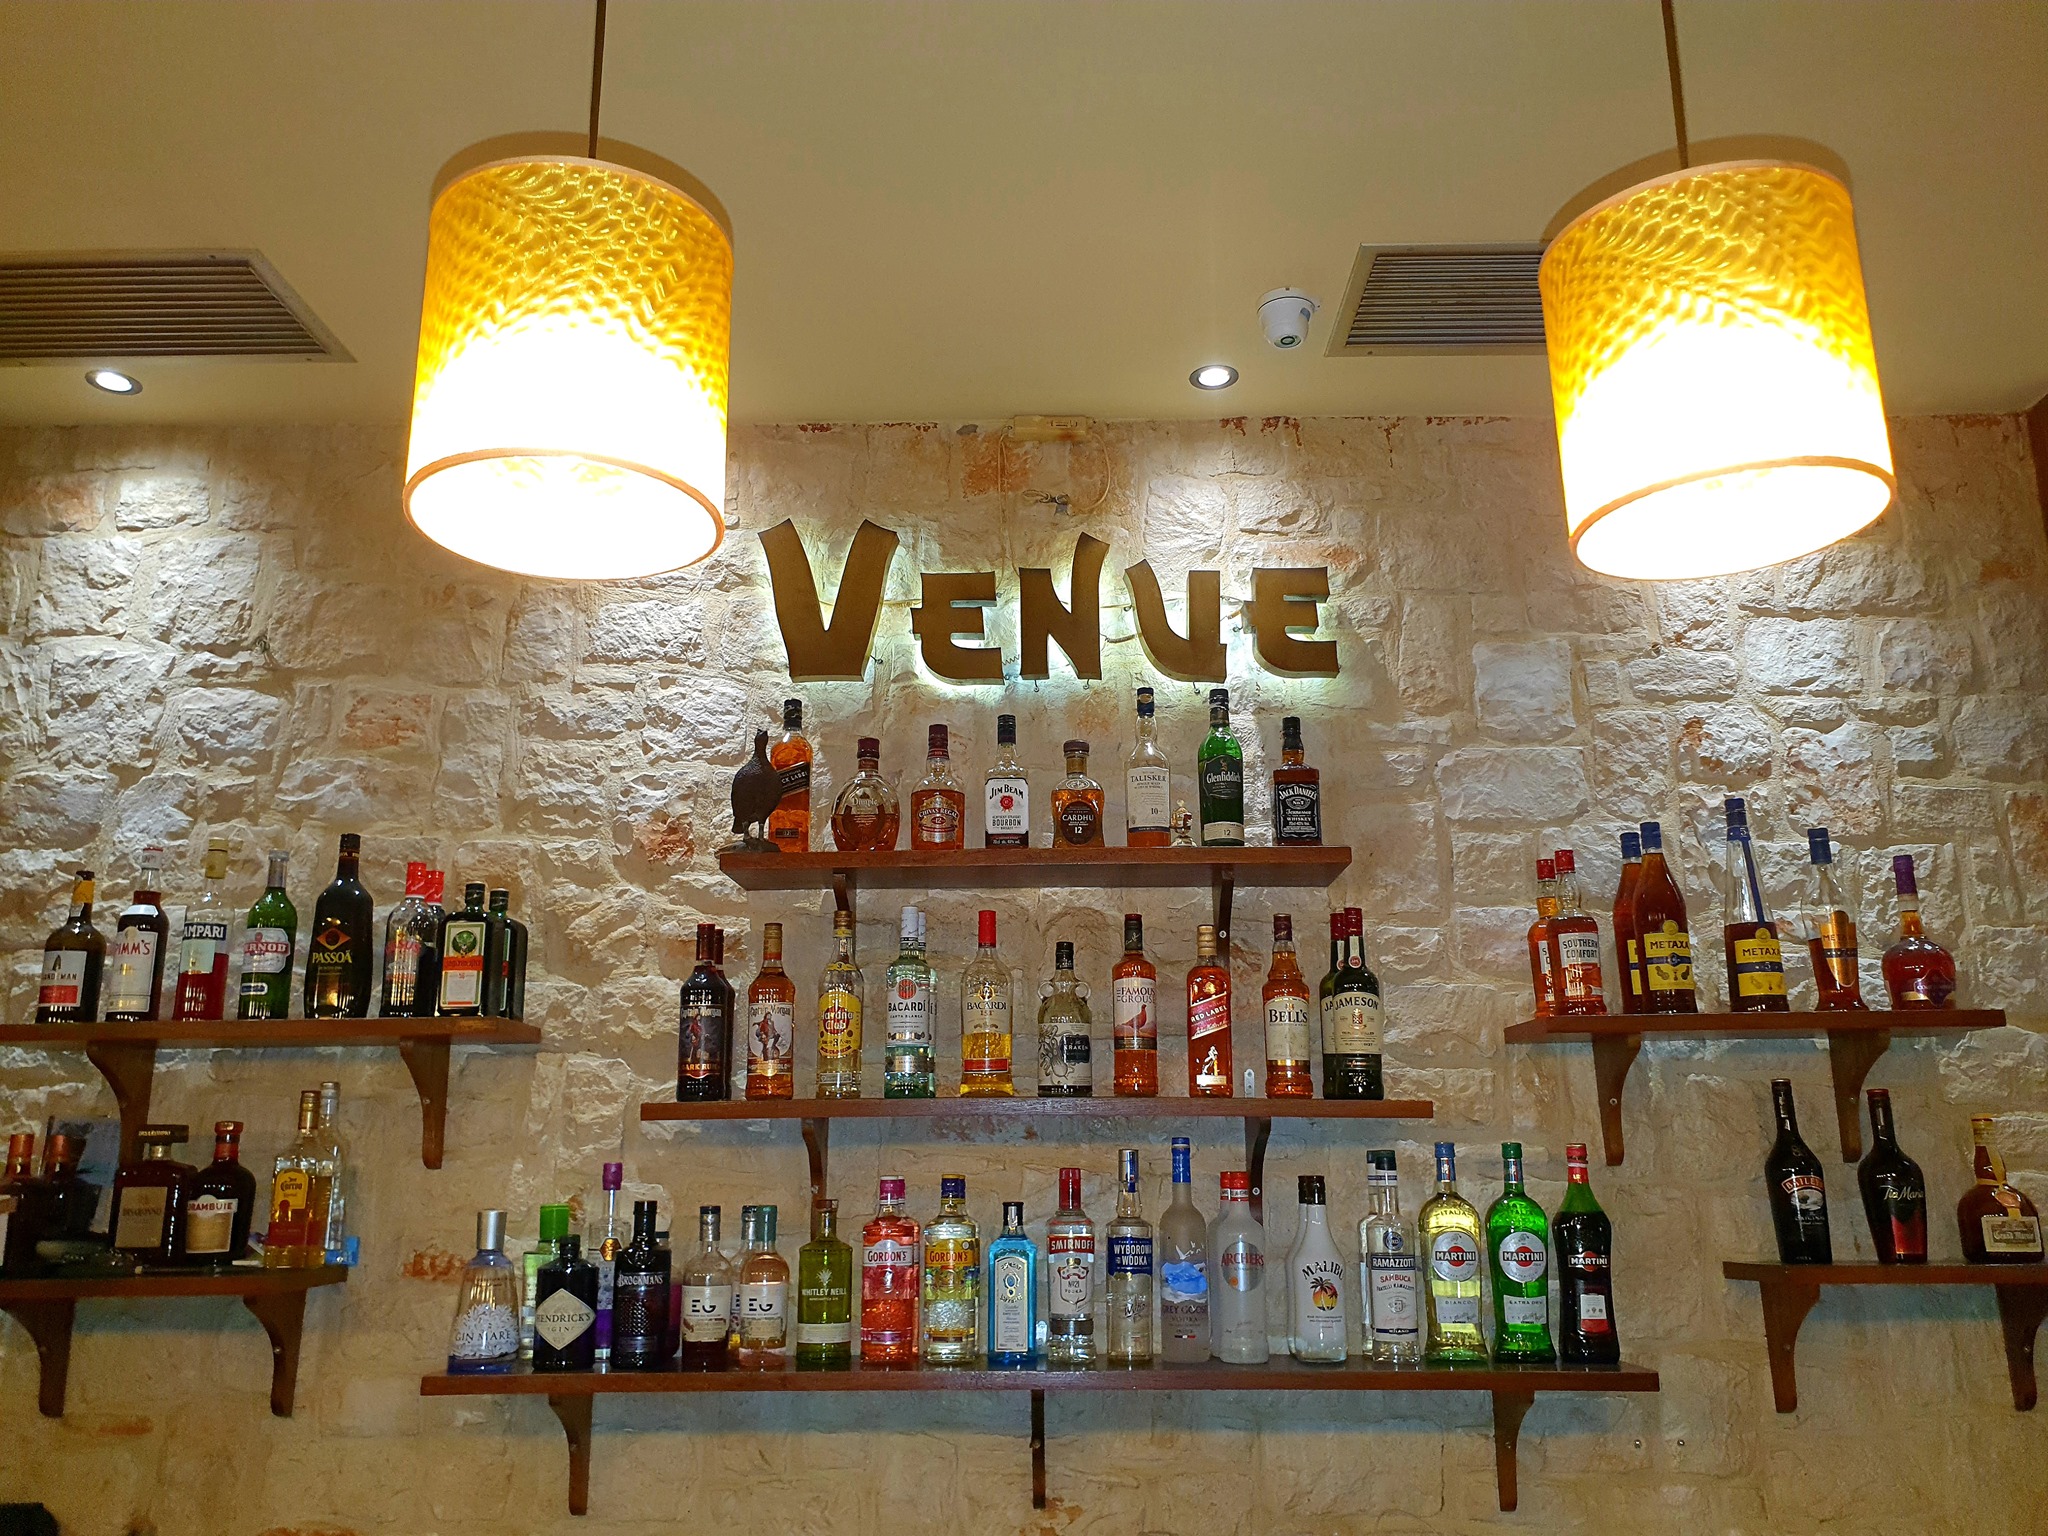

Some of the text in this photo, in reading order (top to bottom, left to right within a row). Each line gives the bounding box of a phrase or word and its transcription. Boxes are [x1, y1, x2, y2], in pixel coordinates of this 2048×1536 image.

[759, 518, 1338, 685] VENUE
[1131, 774, 1167, 783] TALISKER
[989, 783, 1024, 800] JIM BEAM
[1278, 785, 1318, 800] JACK DANIEL'S
[918, 807, 959, 819] CHIVAS REGAL
[1150, 807, 1159, 815] 10
[992, 819, 1022, 827] BOURBON
[1062, 814, 1095, 822] CARDHU
[1074, 826, 1082, 834] 12
[184, 925, 225, 939] AMPARI
[1562, 938, 1598, 950] SOUTHERN
[1650, 940, 1690, 950] METAXA
[1121, 986, 1156, 996] FAMOUS
[1334, 995, 1379, 1011] JAMESON
[1190, 1004, 1228, 1023] RED LABEL
[1268, 1008, 1308, 1023] BELL'S
[1051, 1239, 1094, 1251] SMIRNOFF
[867, 1250, 907, 1262] GORDON'S
[929, 1250, 969, 1262] GORDON'S
[1221, 1252, 1265, 1268] ARCHERS
[1435, 1251, 1476, 1262] MARTINI
[1503, 1251, 1544, 1262] MARTINI
[1570, 1257, 1609, 1265] MARTINI
[1302, 1260, 1345, 1281] MALIBU
[617, 1272, 664, 1287] BROCKMANS
[1380, 1274, 1411, 1284] SAMBUCA
[802, 1289, 829, 1297] WHITLEY
[455, 1331, 475, 1342] GIN
